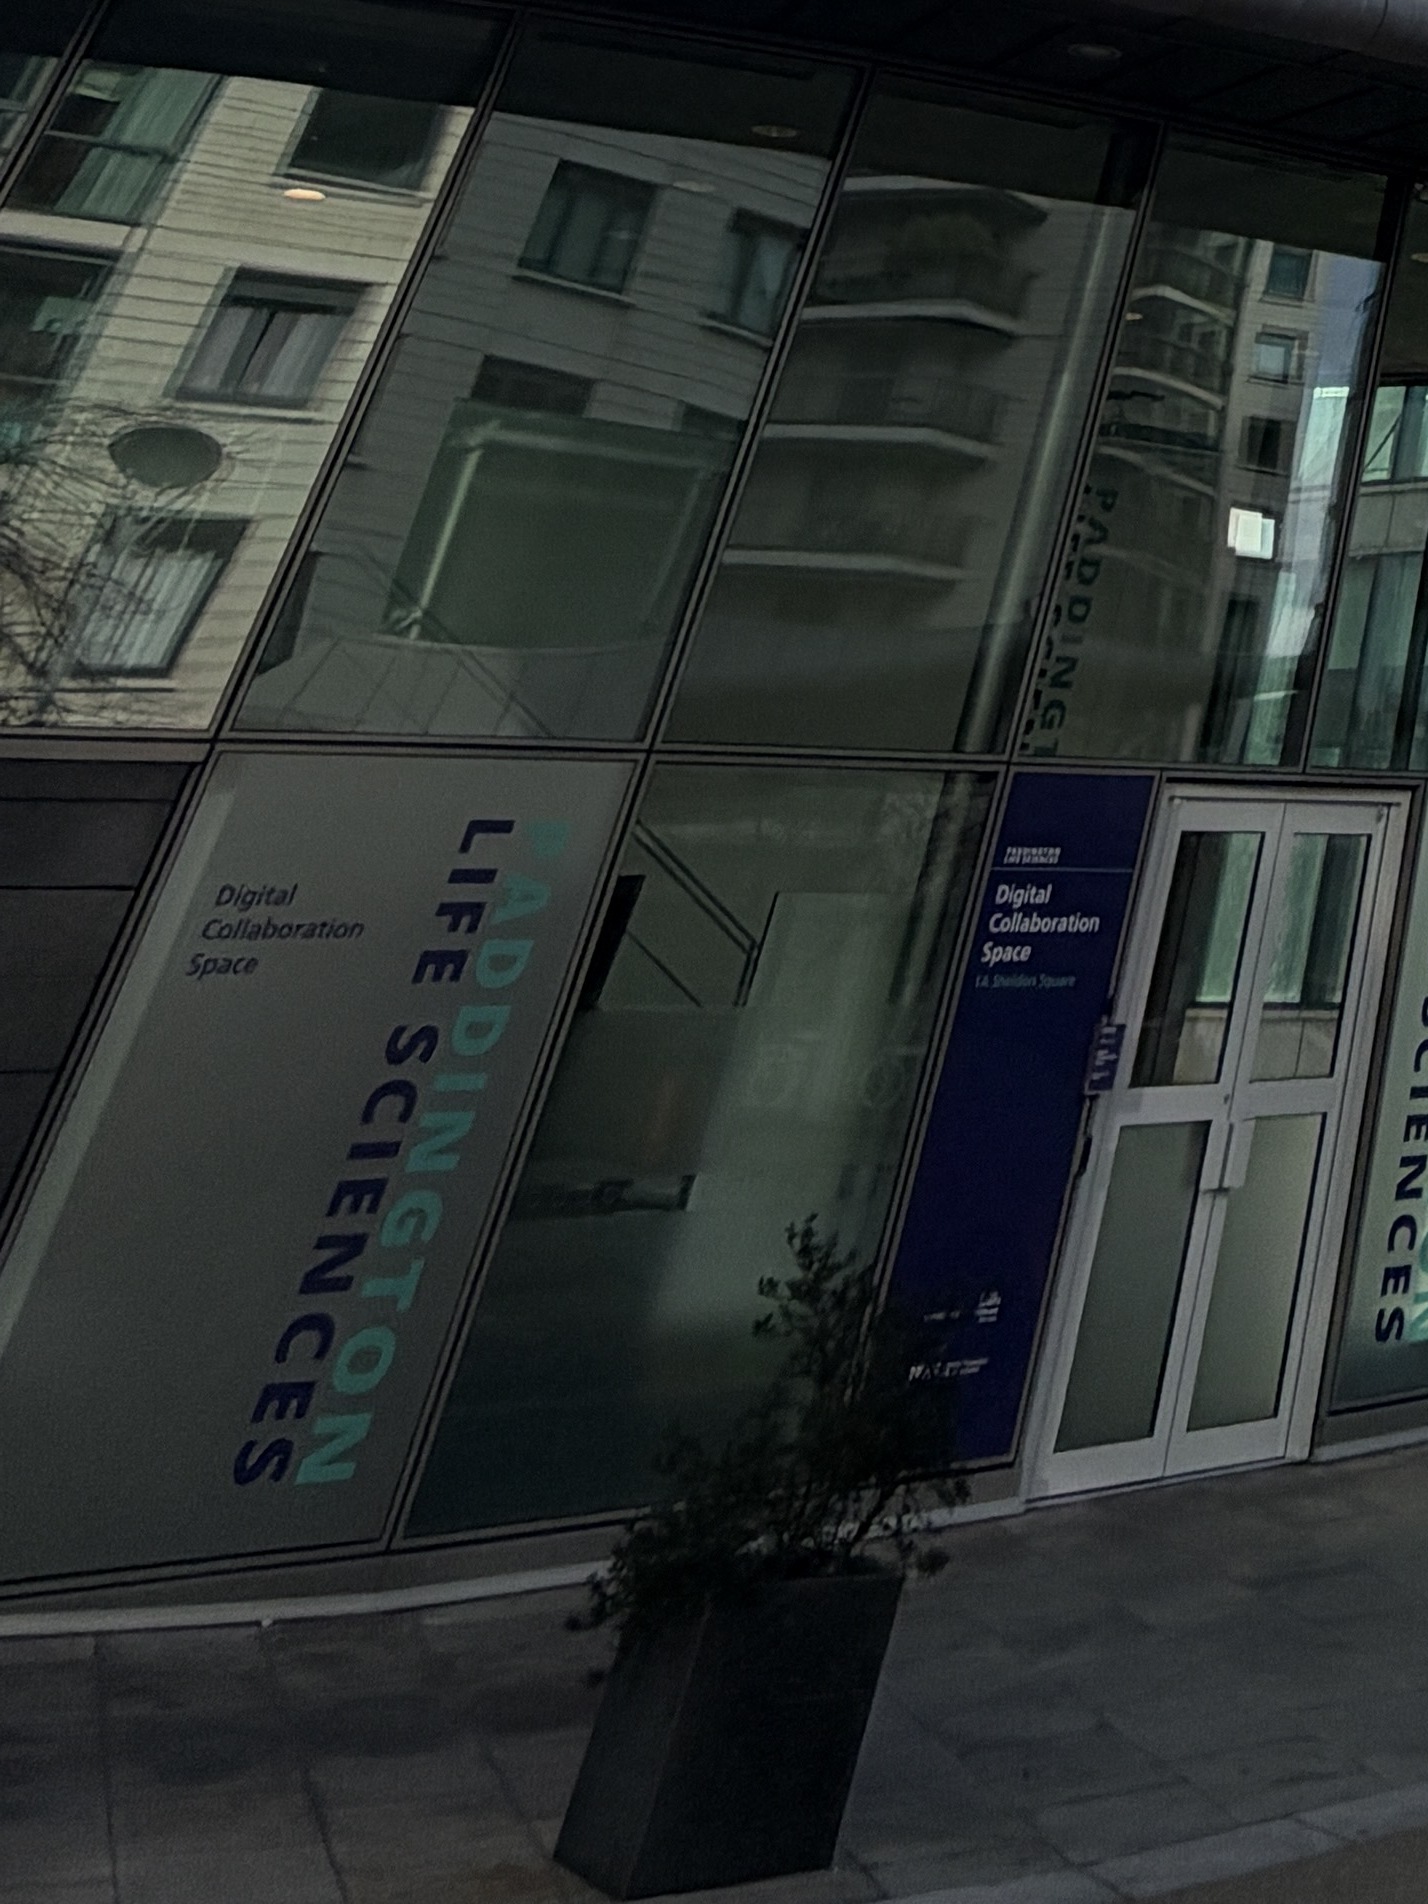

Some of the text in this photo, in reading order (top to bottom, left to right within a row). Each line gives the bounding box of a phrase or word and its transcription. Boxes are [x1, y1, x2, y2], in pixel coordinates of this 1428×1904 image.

[1033, 487, 1118, 757] PADDINGT
[215, 884, 299, 910] Digital
[995, 883, 1053, 909] Digital
[201, 915, 365, 941] Collaboration
[988, 912, 1101, 934] Collaboration
[186, 953, 259, 980] Space
[980, 941, 1033, 968] Space
[233, 817, 516, 1488] LIFE SCIENCES
[295, 816, 572, 1487] PADDINGTON
